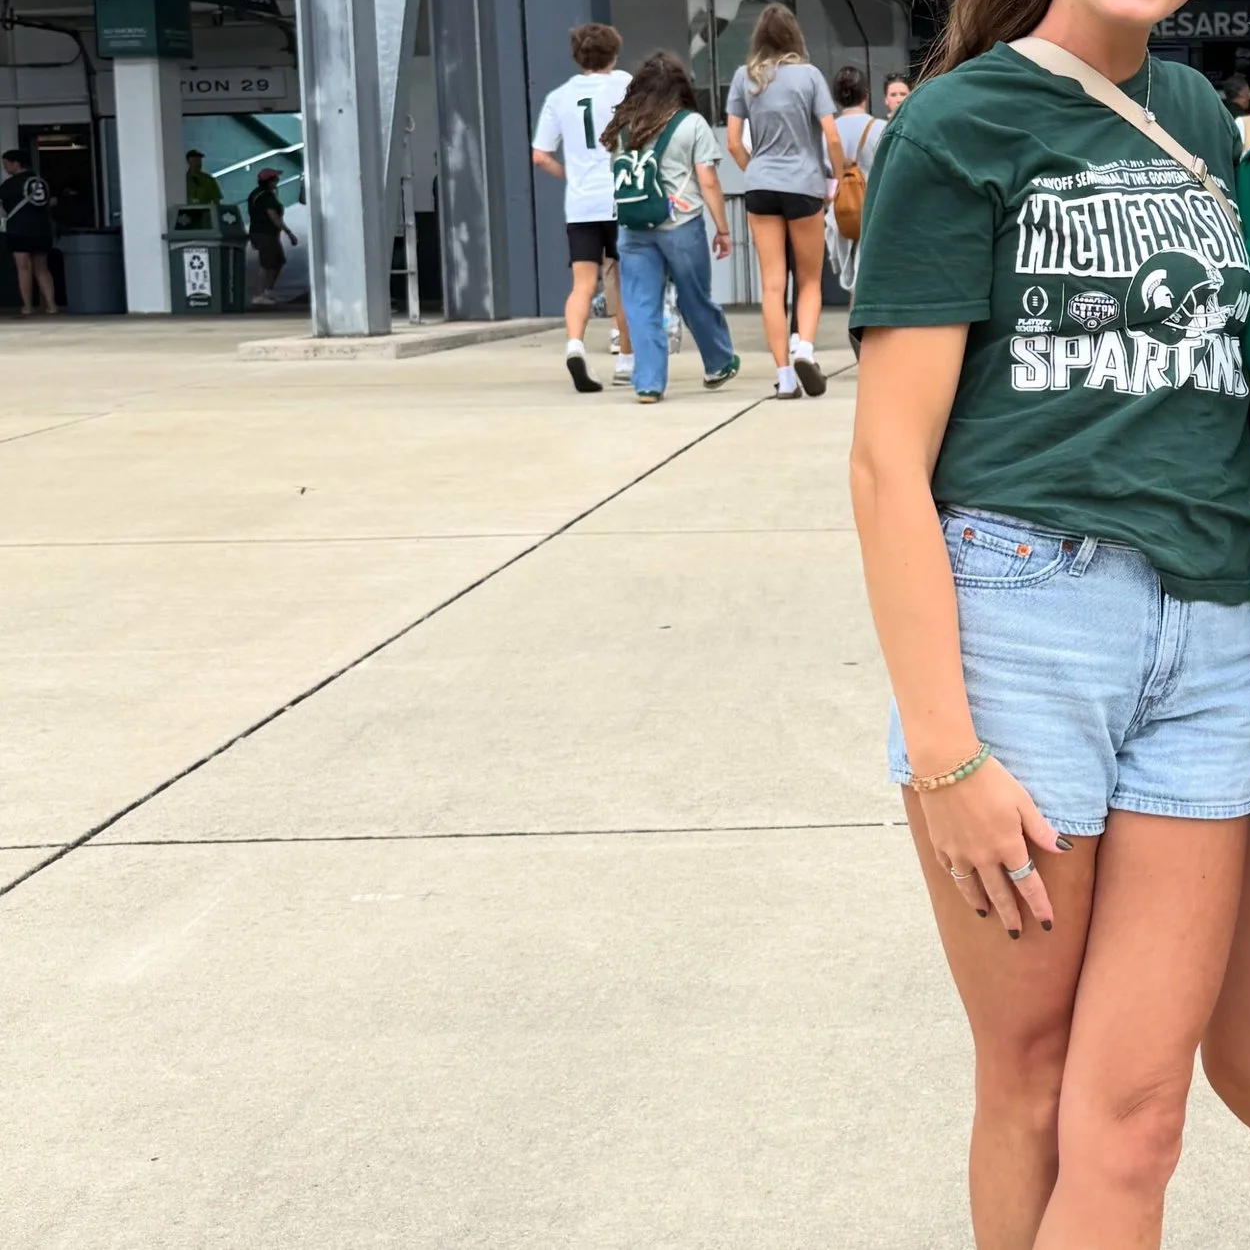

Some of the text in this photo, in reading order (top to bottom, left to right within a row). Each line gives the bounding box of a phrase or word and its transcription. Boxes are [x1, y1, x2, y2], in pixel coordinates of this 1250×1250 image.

[241, 78, 269, 92] 29
[577, 97, 595, 150] 1
[1130, 171, 1149, 186] THE
[1016, 193, 1196, 278] MICHIGAN
[1072, 302, 1116, 316] COTTON
[1011, 330, 1250, 398] SPARTANS
